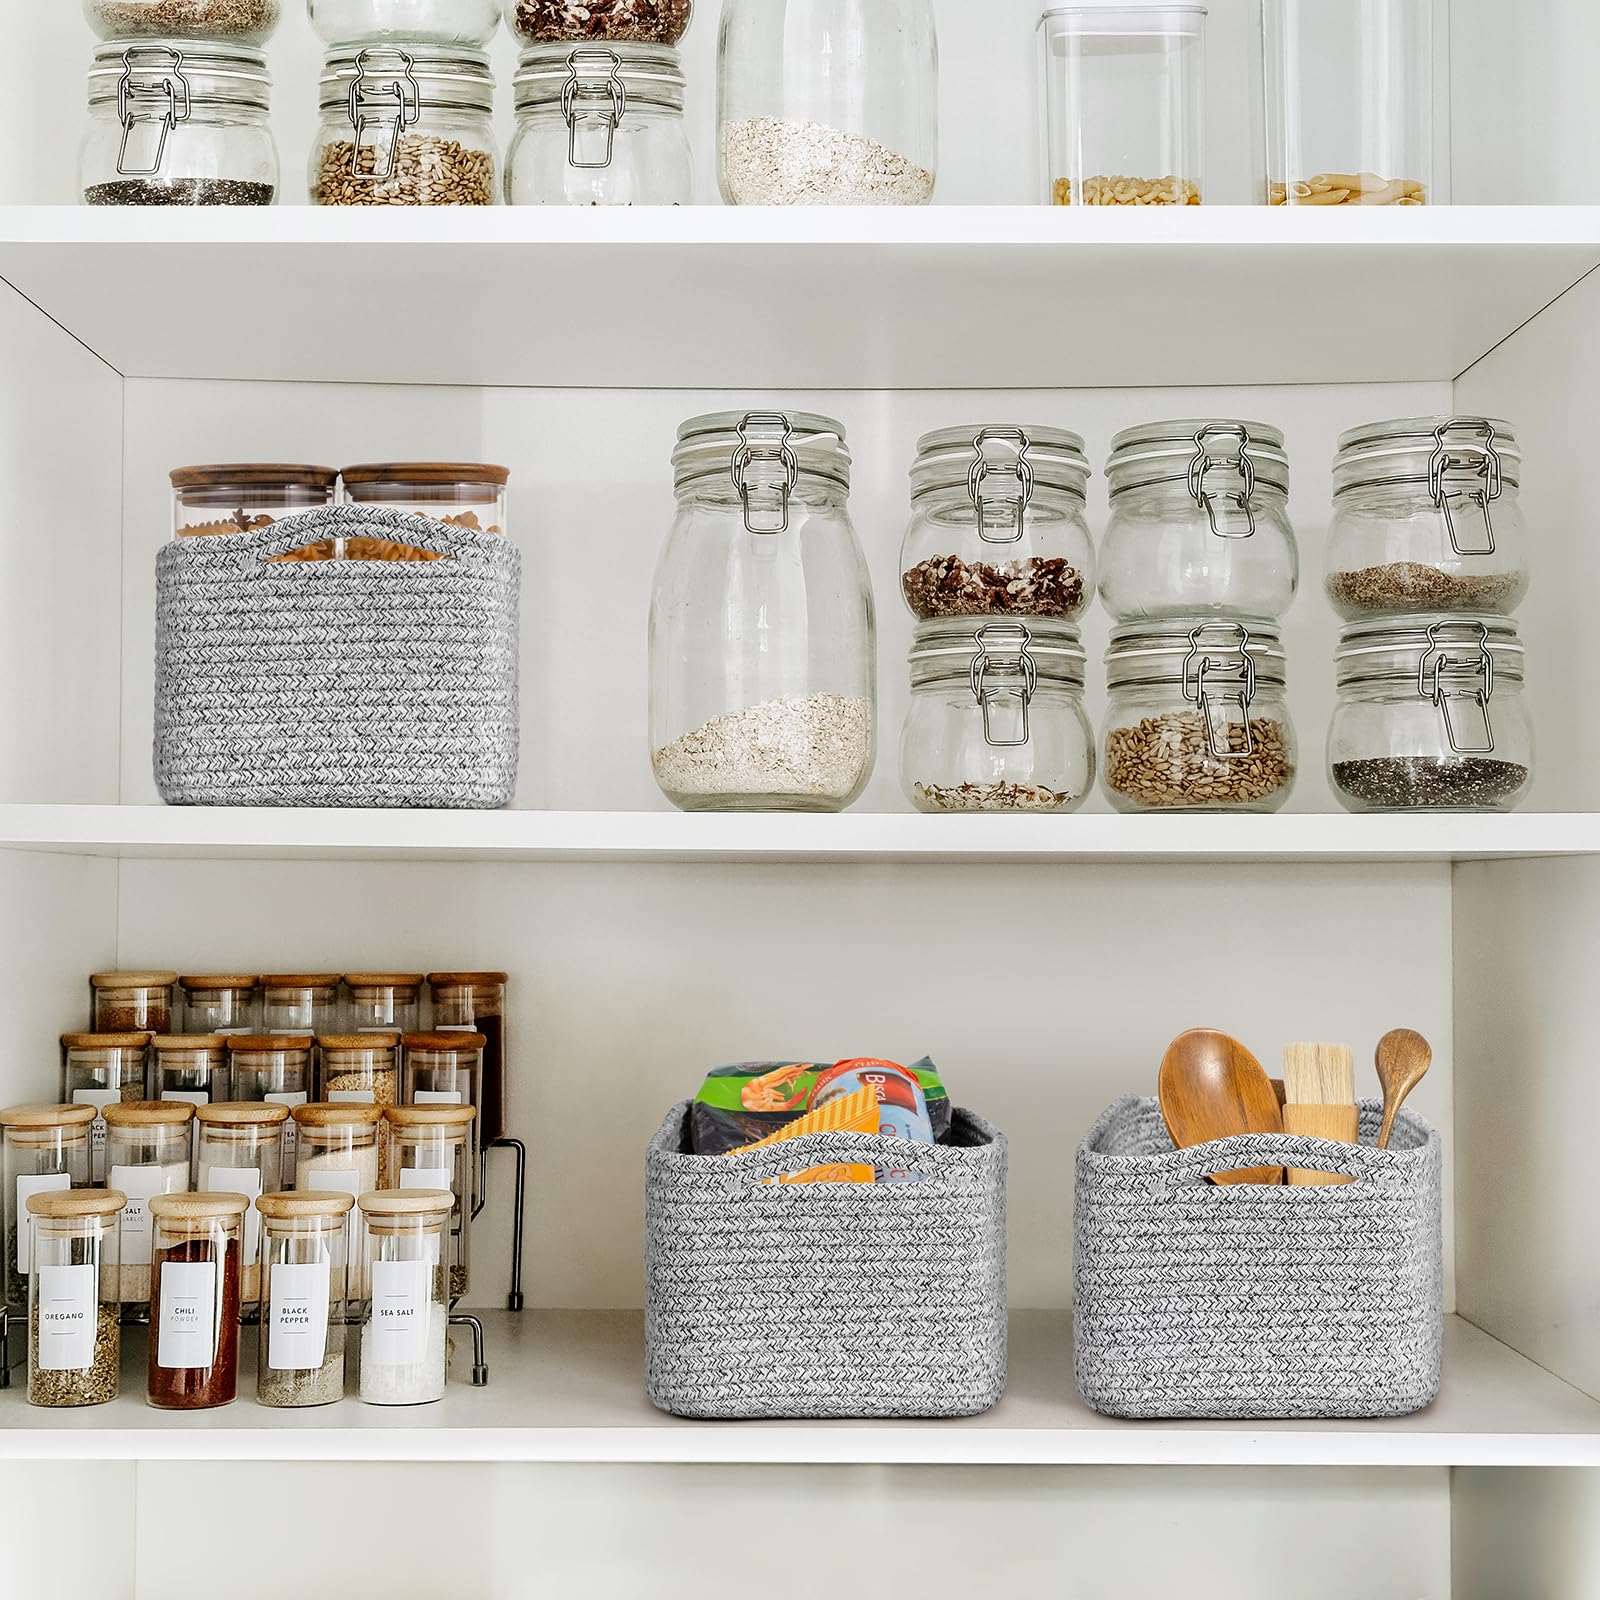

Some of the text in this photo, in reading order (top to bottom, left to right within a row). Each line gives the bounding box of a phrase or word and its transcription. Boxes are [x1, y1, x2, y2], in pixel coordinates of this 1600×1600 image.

[174, 1307, 195, 1315] CHILI
[281, 1307, 308, 1315] BLACK
[396, 1308, 414, 1316] SALT
[44, 1312, 84, 1321] OREGANO
[280, 1316, 309, 1324] PEPPER
